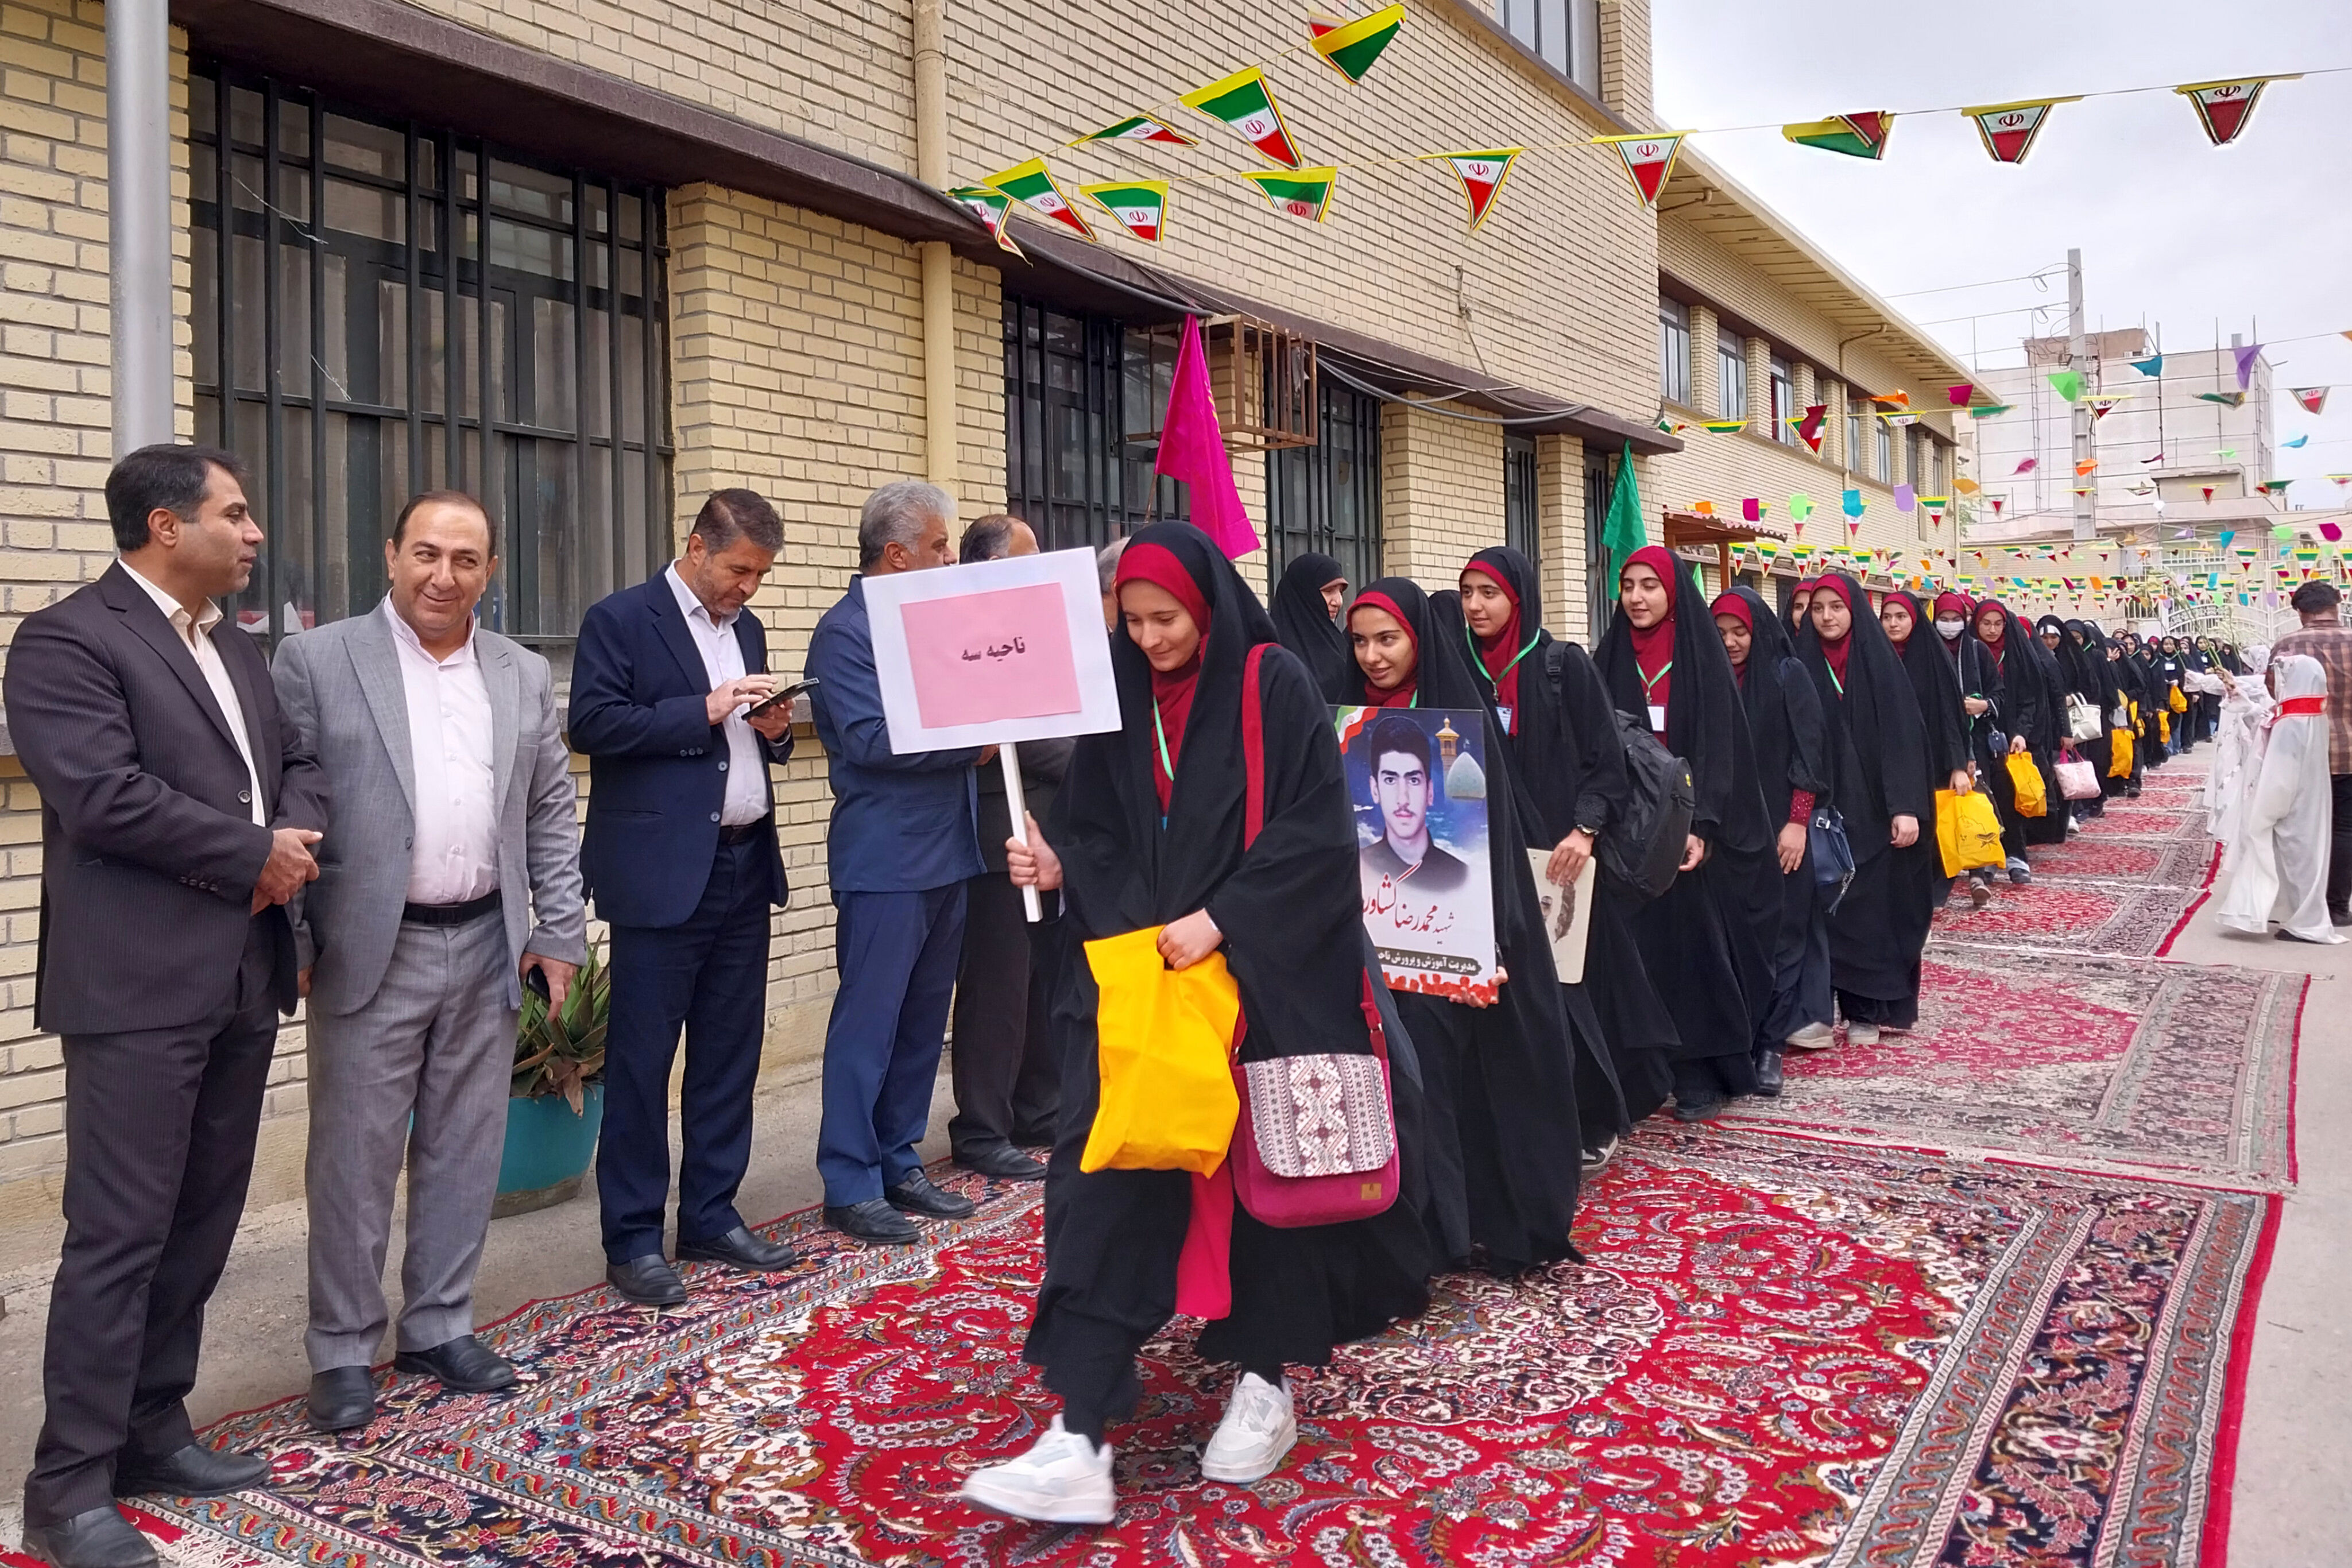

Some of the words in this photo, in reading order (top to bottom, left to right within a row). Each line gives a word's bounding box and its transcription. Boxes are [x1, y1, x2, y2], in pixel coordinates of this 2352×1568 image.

[962, 649, 981, 661] سه
[987, 636, 1025, 661] ناحیه
[1362, 861, 1421, 914] کشاور
[1433, 912, 1454, 945] شهید
[1378, 950, 1390, 960] ناح
[1391, 952, 1415, 966] پرورش
[1416, 958, 1421, 967] و
[1422, 956, 1447, 969] آموزش
[1448, 961, 1476, 973] مدیریت
